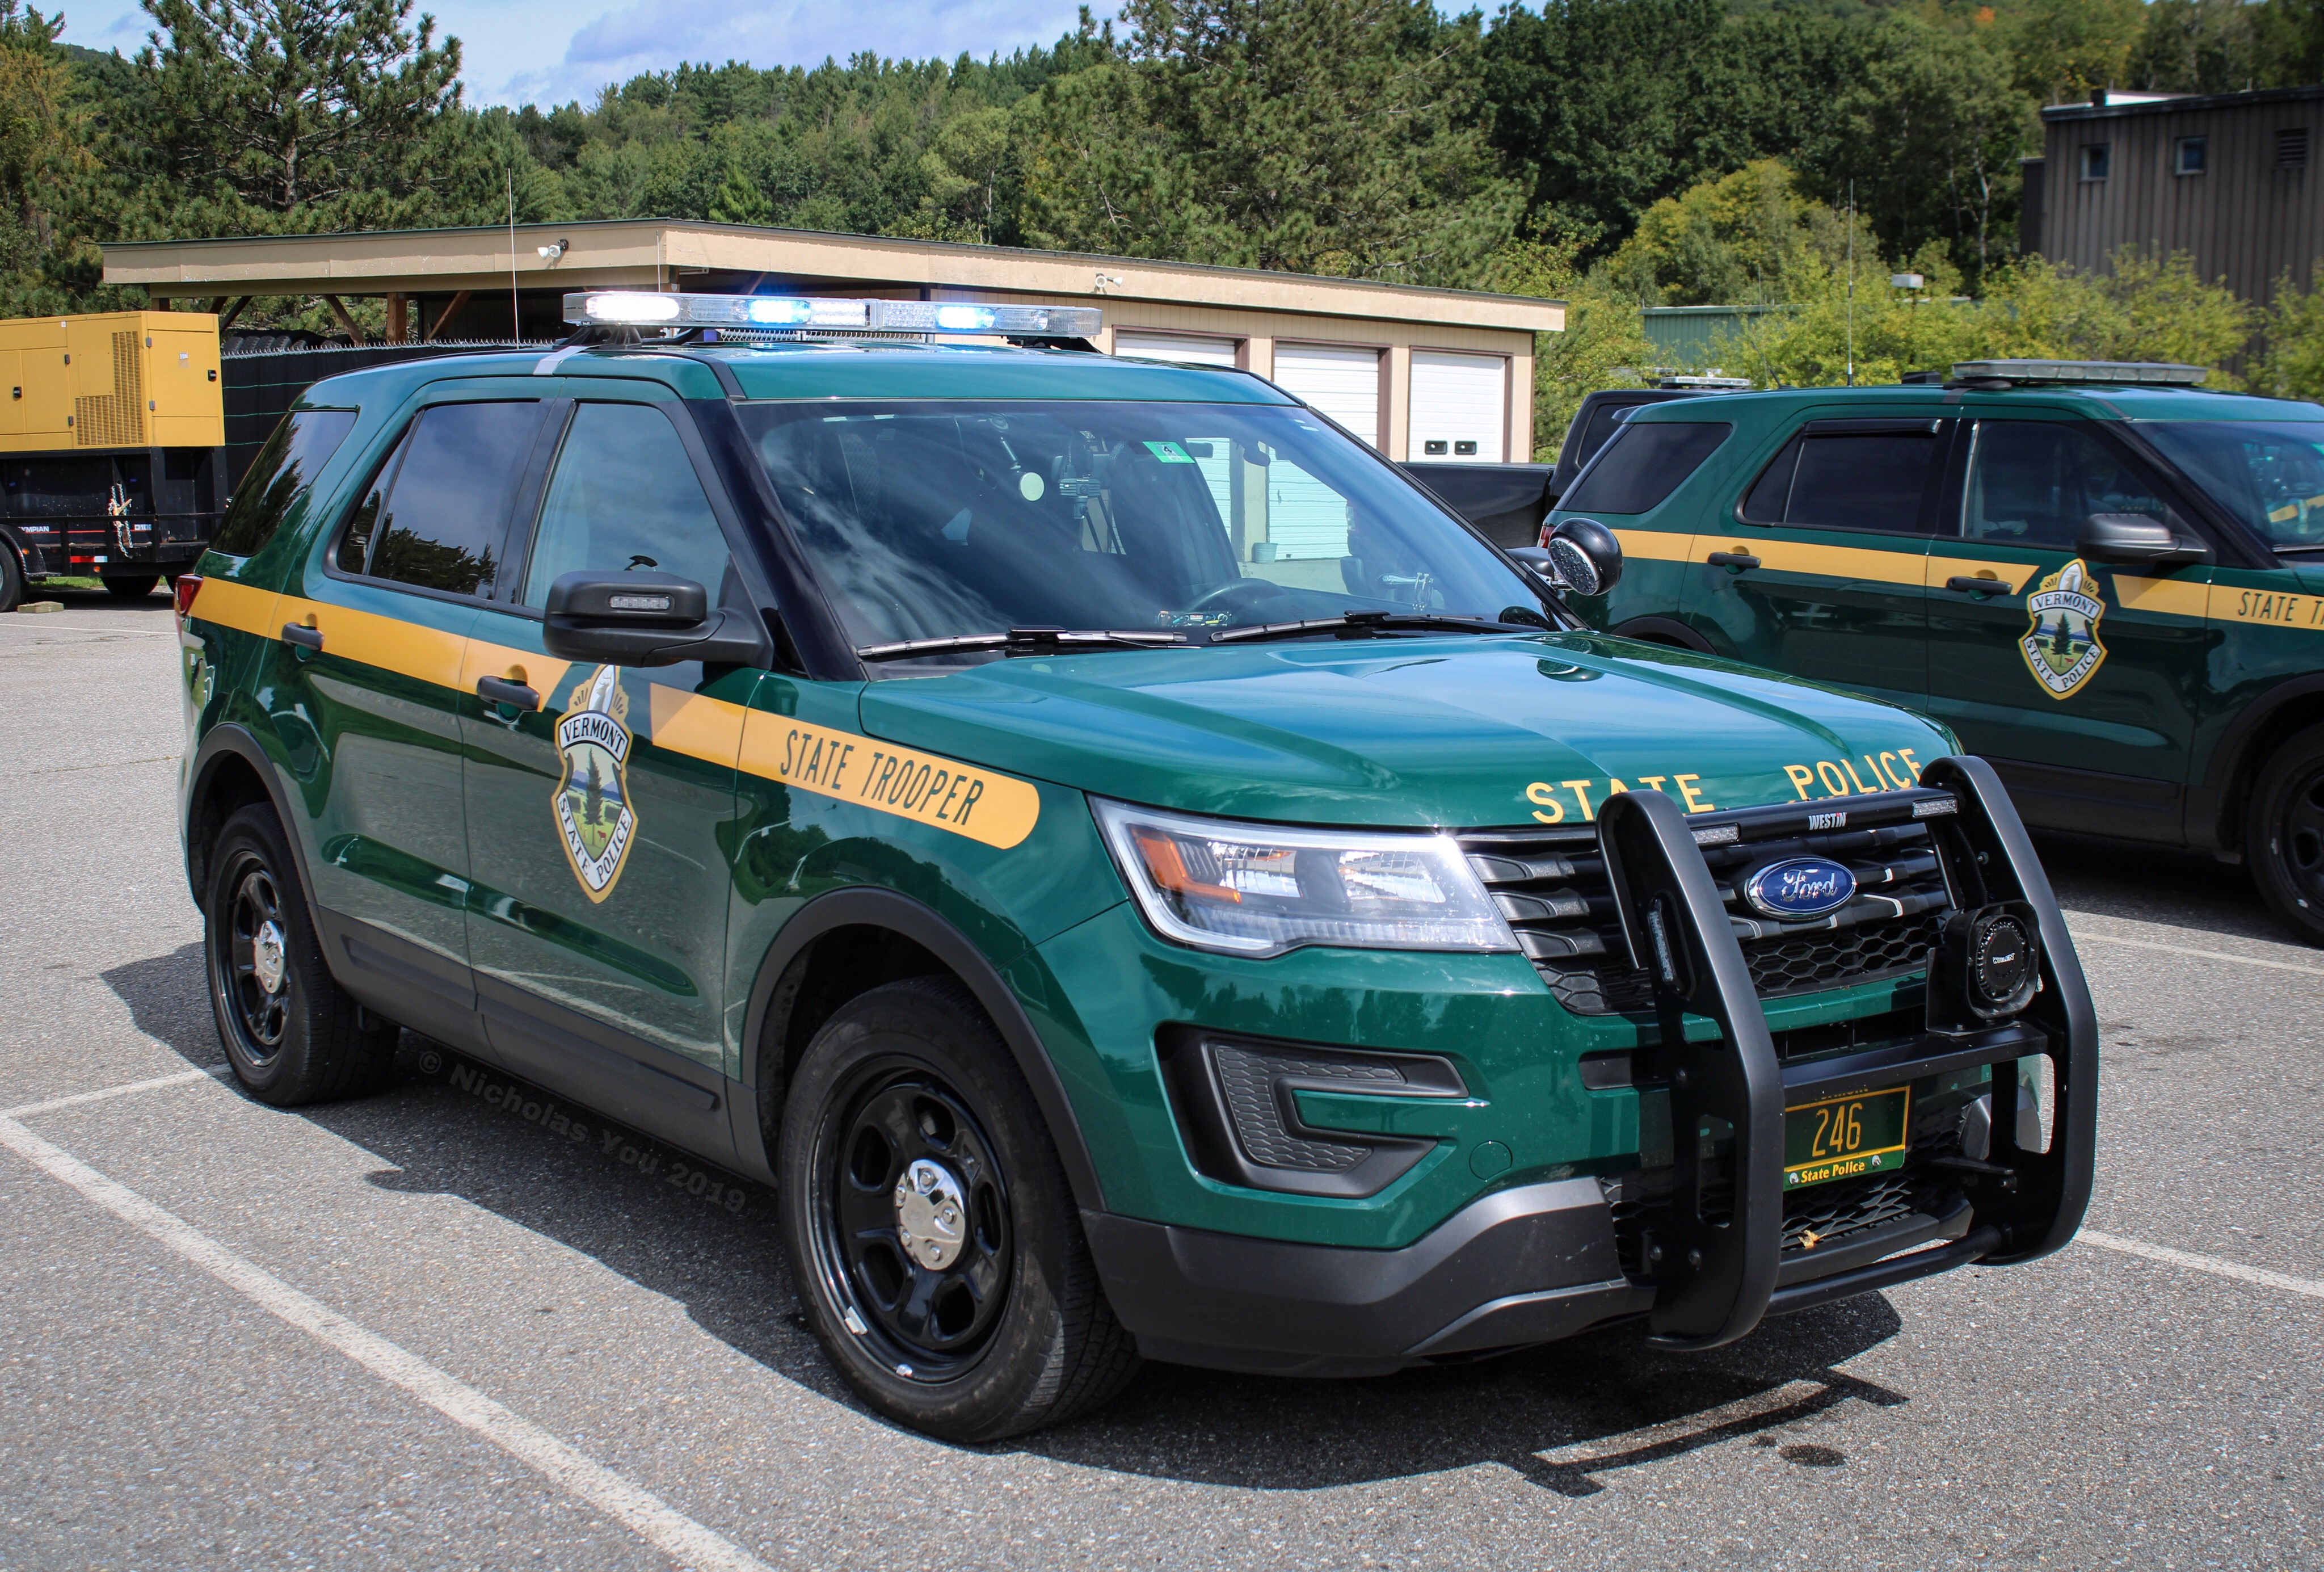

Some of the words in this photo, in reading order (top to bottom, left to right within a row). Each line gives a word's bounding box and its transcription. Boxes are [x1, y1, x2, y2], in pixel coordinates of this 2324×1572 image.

[2036, 594, 2098, 615] VERMONT
[2238, 591, 2298, 621] STATE
[2311, 600, 2324, 625] T
[2027, 640, 2055, 684] STATE
[2061, 648, 2098, 688] POLICE
[563, 717, 625, 754] VERMONT
[780, 729, 854, 790] STATE
[860, 752, 984, 826] TROOPER
[1783, 749, 1922, 800] POLICE
[559, 798, 591, 876] STATE
[596, 814, 630, 884] POLICE
[1781, 867, 1838, 902] Ford
[1812, 1102, 1863, 1157] 246
[1801, 1167, 1830, 1183] State
[1832, 1161, 1866, 1177] Police
